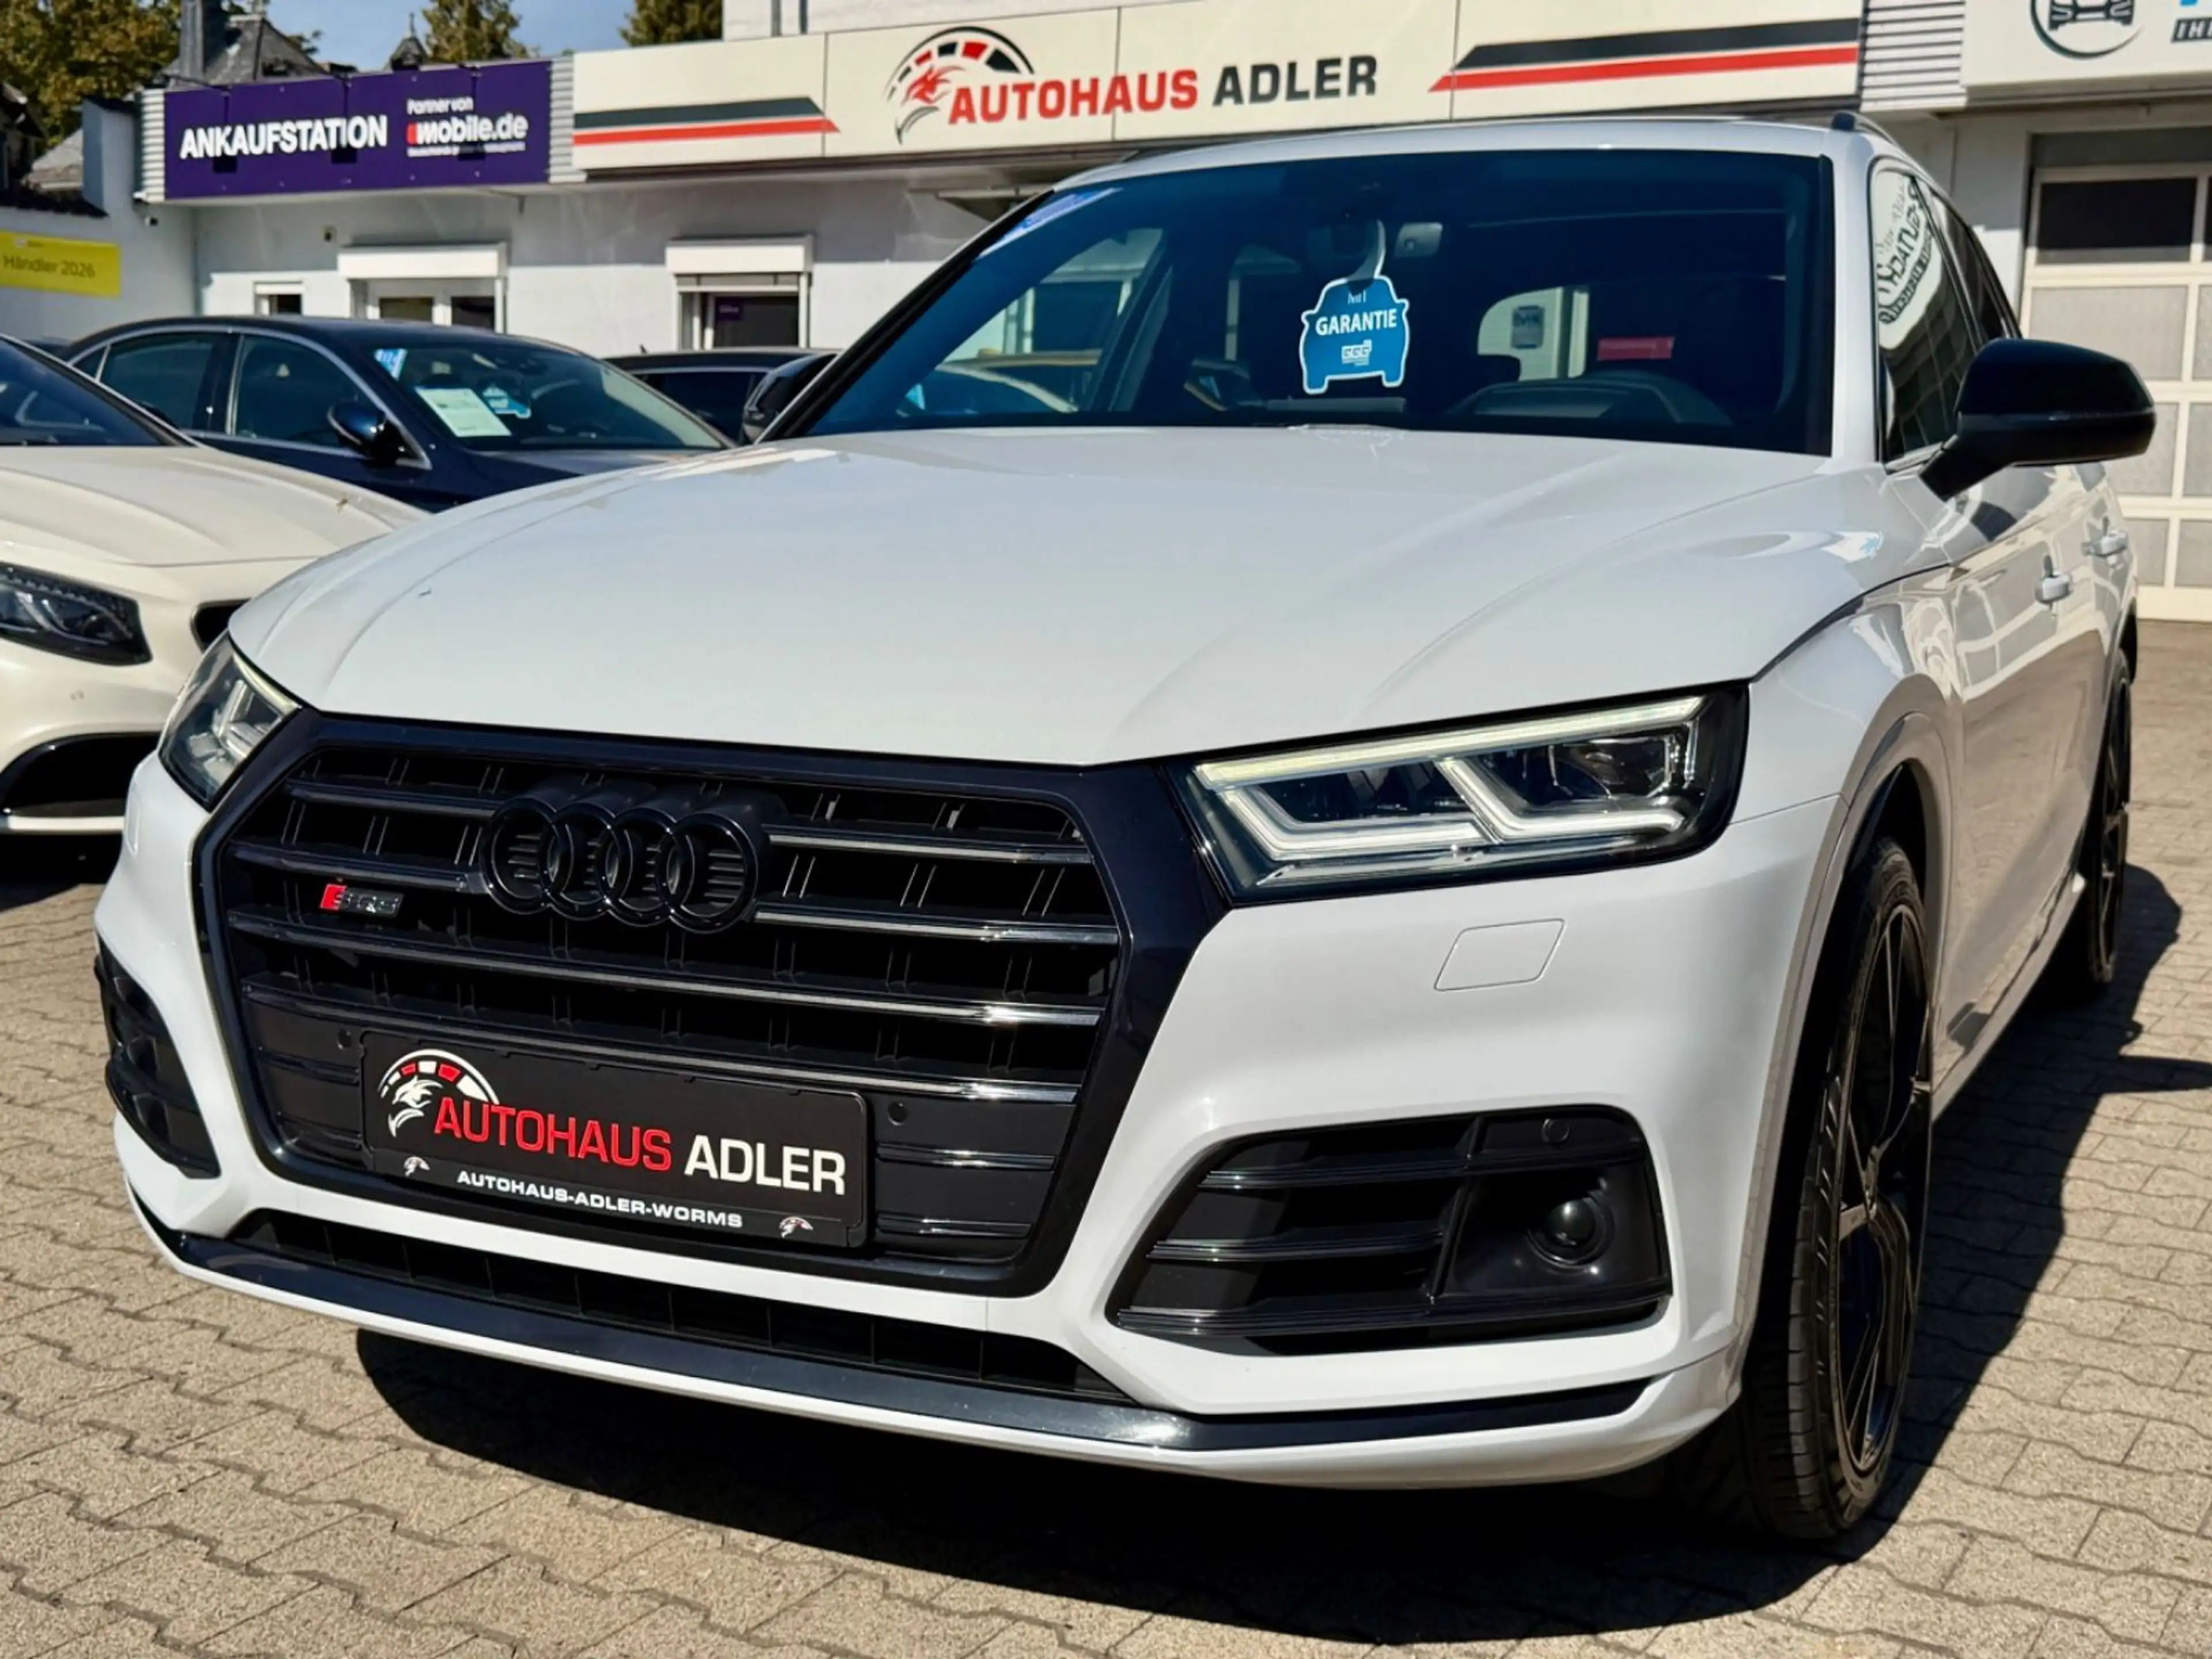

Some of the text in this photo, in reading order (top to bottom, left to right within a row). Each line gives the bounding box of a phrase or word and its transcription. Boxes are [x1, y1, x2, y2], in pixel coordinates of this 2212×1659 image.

[407, 96, 474, 115] Partner von
[948, 55, 1378, 126] AUTOHAUS ADLER
[179, 113, 388, 160] ANKAUFSTATION
[416, 112, 528, 143] mobile.de
[3, 255, 58, 274] Händler
[1315, 308, 1397, 336] GARANTIE
[433, 1096, 846, 1195] AUTOHAUS ADLER
[457, 1170, 743, 1228] AUTOHAUS-ADLER-WORMS
